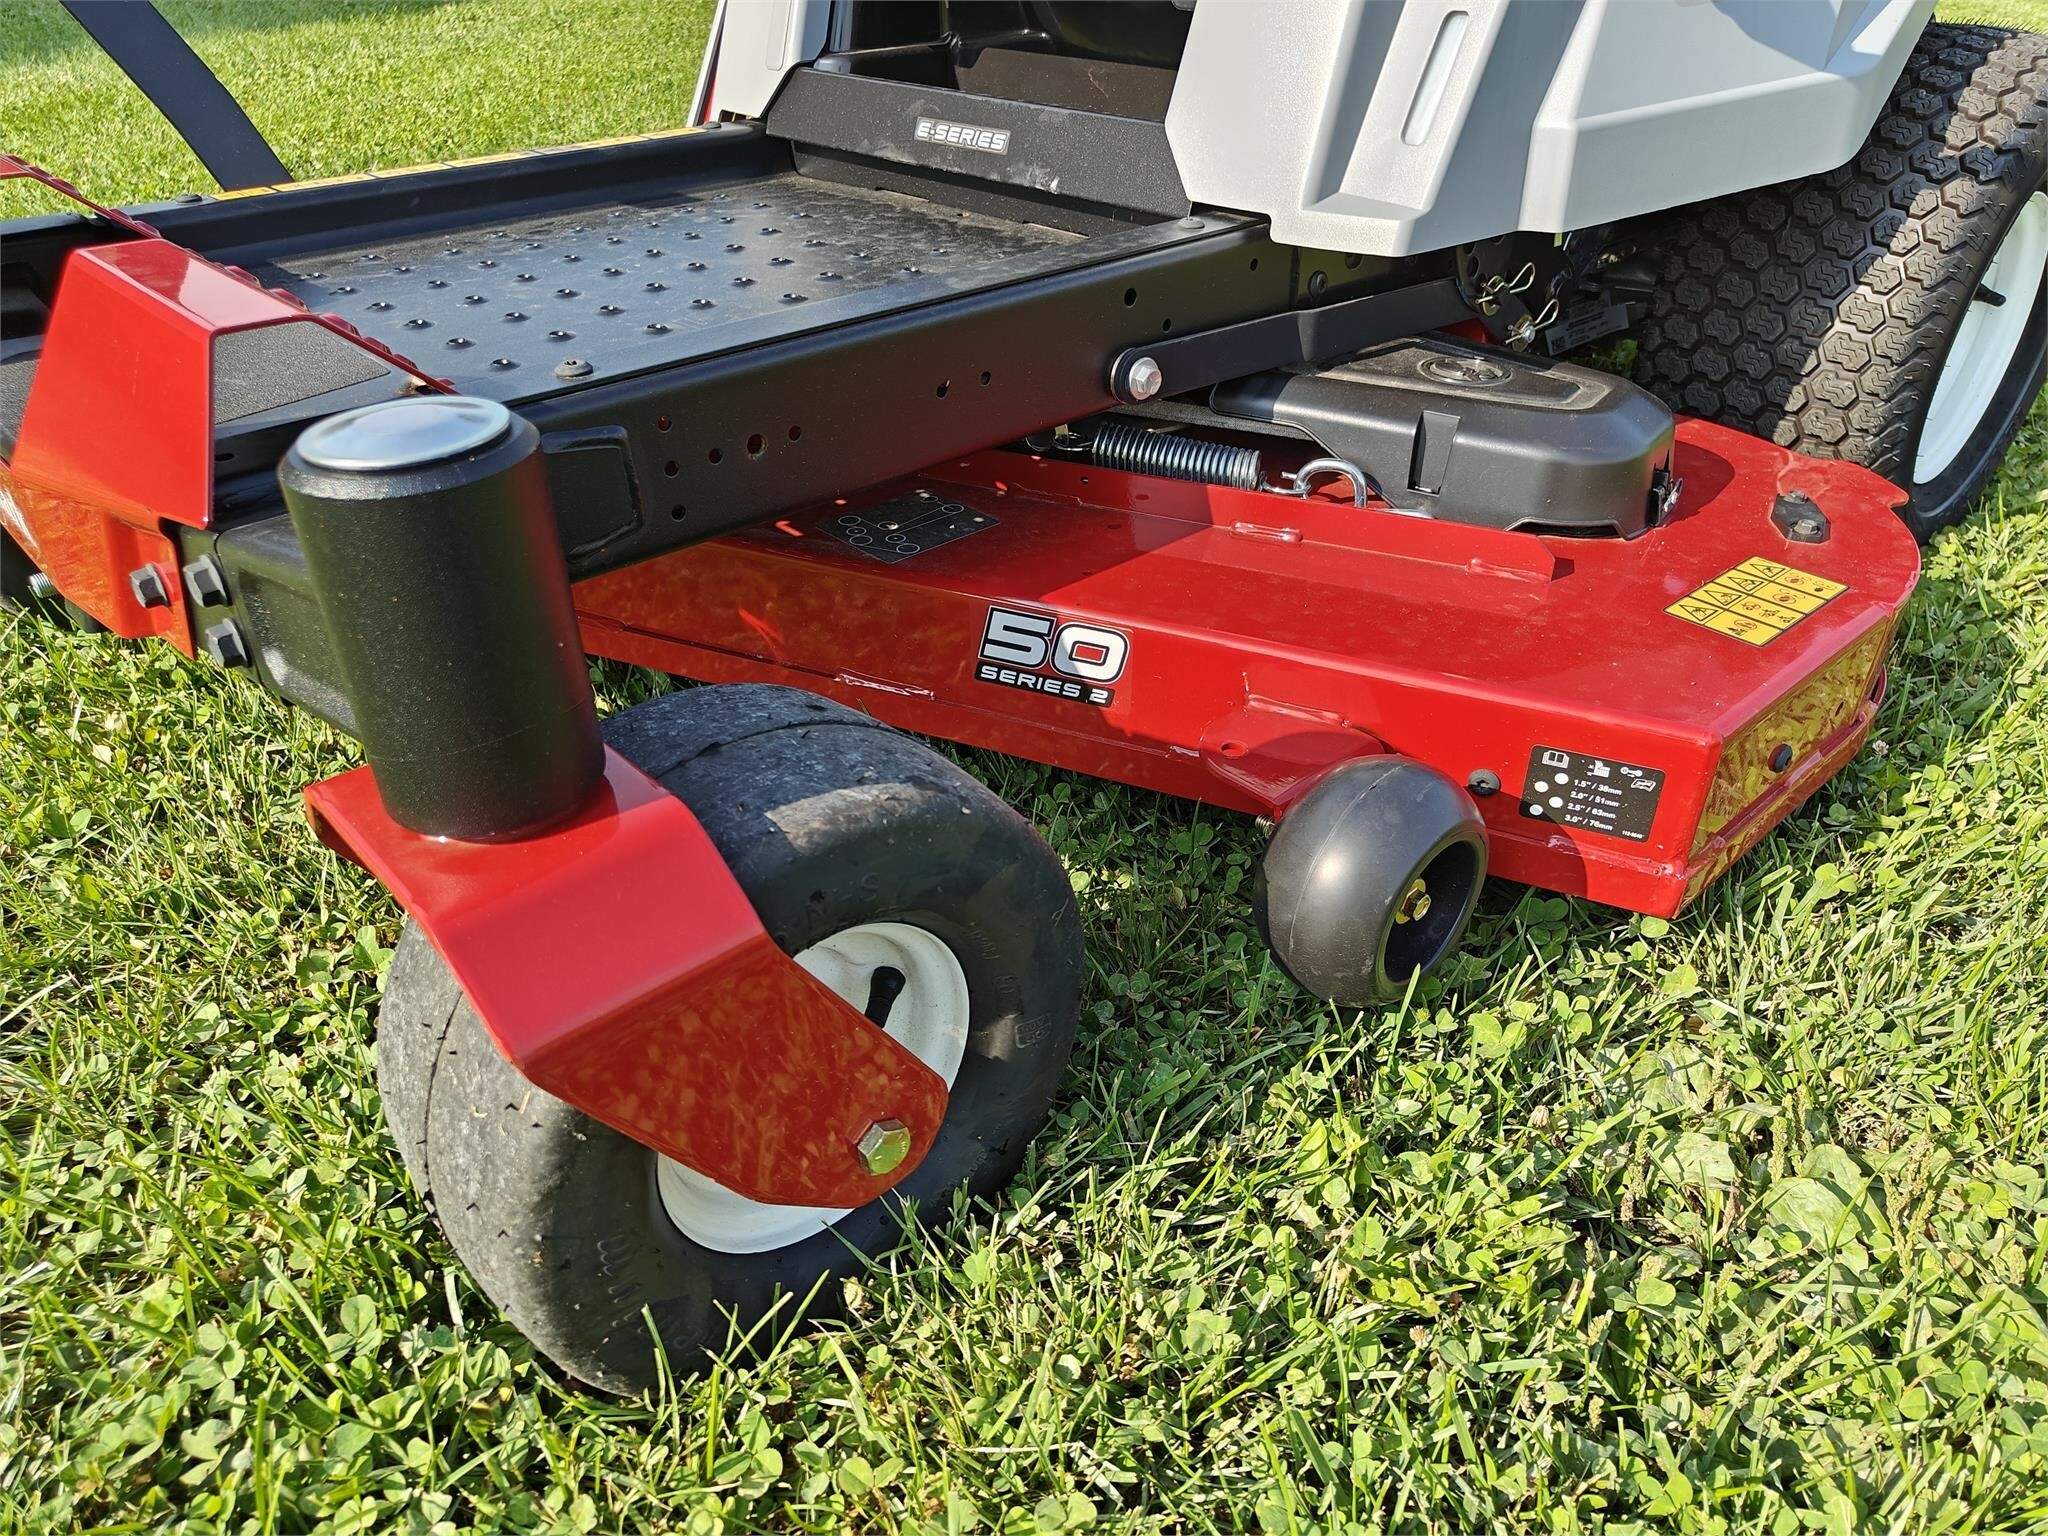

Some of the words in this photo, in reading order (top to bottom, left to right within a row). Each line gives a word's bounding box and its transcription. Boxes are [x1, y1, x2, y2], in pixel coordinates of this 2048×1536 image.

[980, 607, 1128, 683] 50
[980, 665, 1082, 698] SERIES
[1089, 688, 1109, 704] 2
[1598, 784, 1622, 795] 38mm
[1594, 795, 1619, 807] 51mm
[1591, 808, 1616, 819] 63mm
[1589, 819, 1613, 831] 76mm
